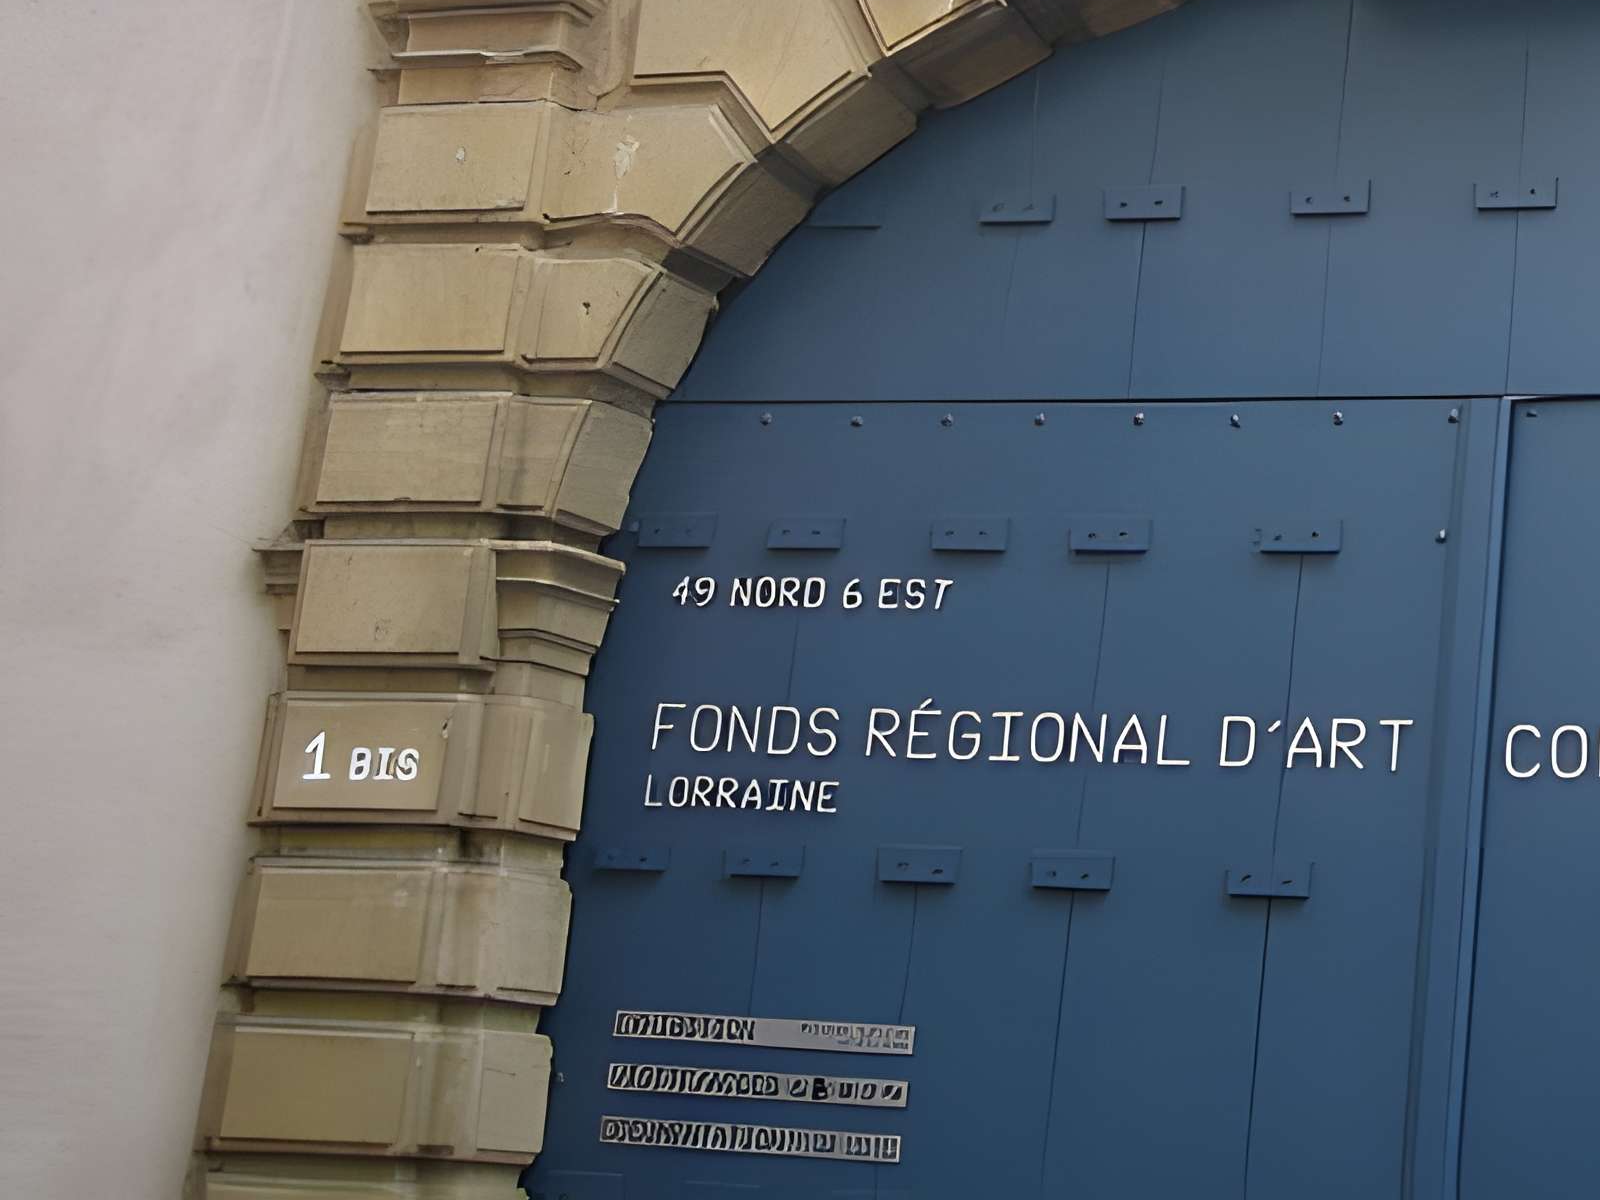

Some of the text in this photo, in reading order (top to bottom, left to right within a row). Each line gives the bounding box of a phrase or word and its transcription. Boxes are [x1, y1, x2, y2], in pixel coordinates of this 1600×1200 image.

[672, 575, 954, 610] 49 NORD 6 EST
[651, 703, 840, 756] FONDS
[865, 698, 1190, 766] RÉGIONAL
[302, 731, 419, 781] 1 BIS
[644, 774, 840, 813] LORRAINE
